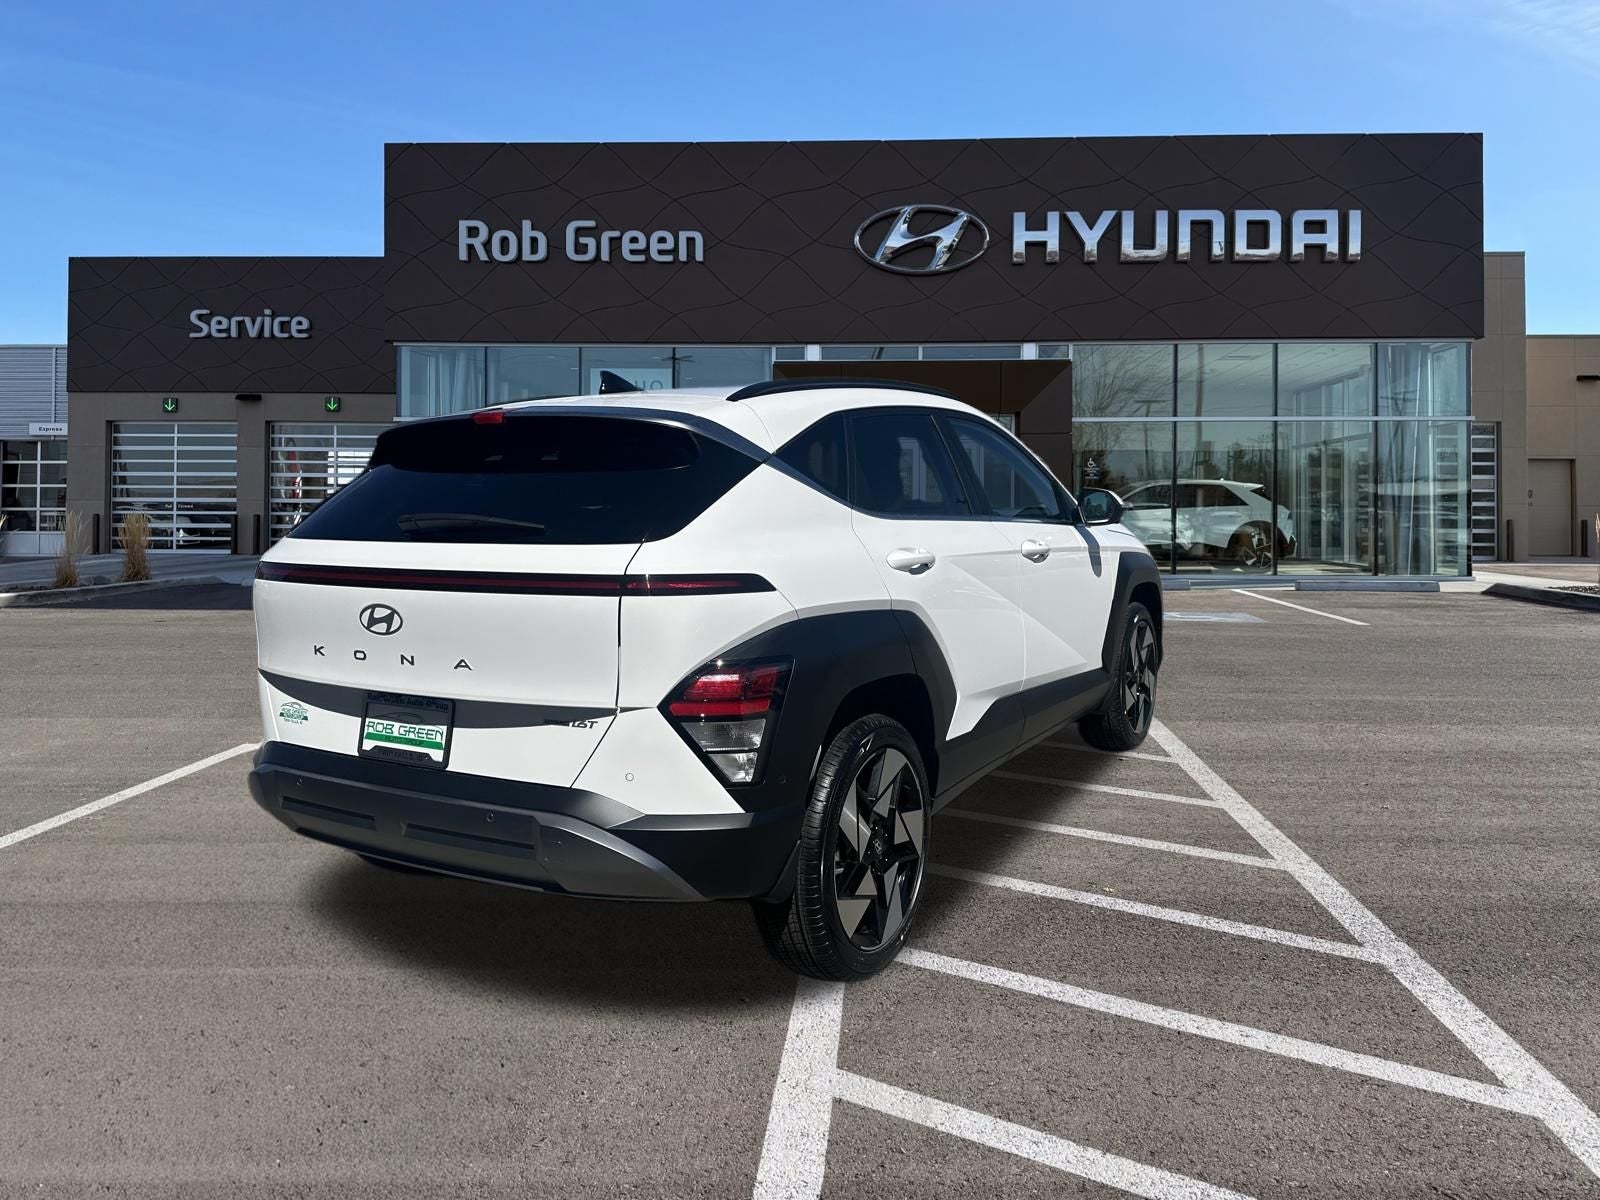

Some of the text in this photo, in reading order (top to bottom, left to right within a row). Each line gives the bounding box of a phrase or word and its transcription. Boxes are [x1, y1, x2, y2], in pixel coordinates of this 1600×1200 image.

[458, 219, 704, 262] Rob Green
[1011, 209, 1362, 264] HYUNDAI
[189, 309, 310, 338] Service
[313, 645, 472, 671] KONA
[367, 721, 443, 741] ROB GREEN
